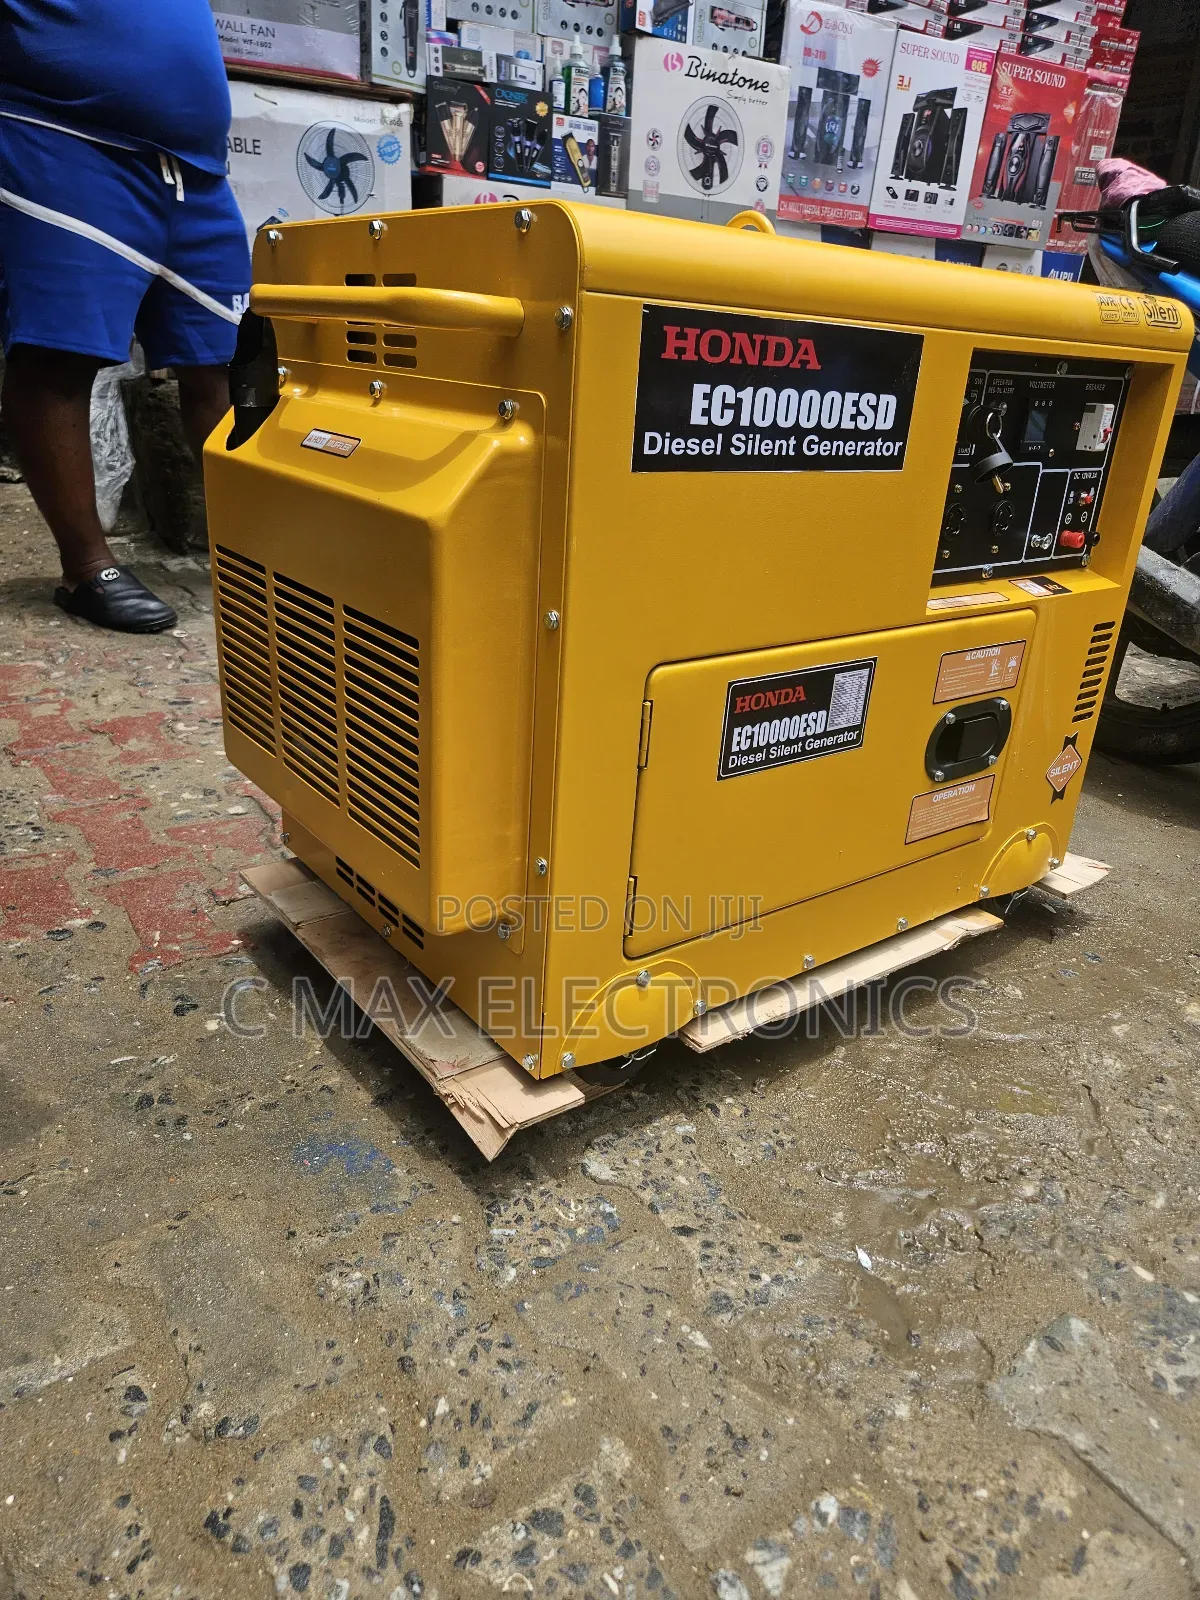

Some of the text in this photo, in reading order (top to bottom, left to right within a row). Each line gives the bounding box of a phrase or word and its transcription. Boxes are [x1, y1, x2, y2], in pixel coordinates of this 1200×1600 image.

[250, 24, 276, 38] FAN
[900, 42, 930, 59] SUPER
[930, 48, 960, 65] SOUND
[684, 55, 770, 93] Binatone
[971, 59, 988, 73] 605
[999, 61, 1066, 89] SUPER SOUND
[897, 74, 912, 88] 3.1
[726, 89, 768, 105] Simply better
[821, 206, 844, 219] SPEAKER
[843, 209, 864, 220] SYSTEM
[1098, 295, 1118, 306] AVR
[1142, 300, 1179, 321] Silent
[661, 325, 822, 370] HONDA
[1029, 380, 1056, 389] VOLTMETER
[1085, 383, 1106, 391] BREAKER
[689, 383, 897, 431] EC10000ESD
[643, 432, 903, 456] Diesel Silent Generator
[971, 646, 1002, 660] CAUTION
[734, 685, 806, 714] HONDA
[731, 709, 828, 753] EC10000ESD
[728, 730, 859, 769] Diesel Silent Generator
[1049, 760, 1079, 778] SILENT
[932, 783, 976, 803] OPERATION
